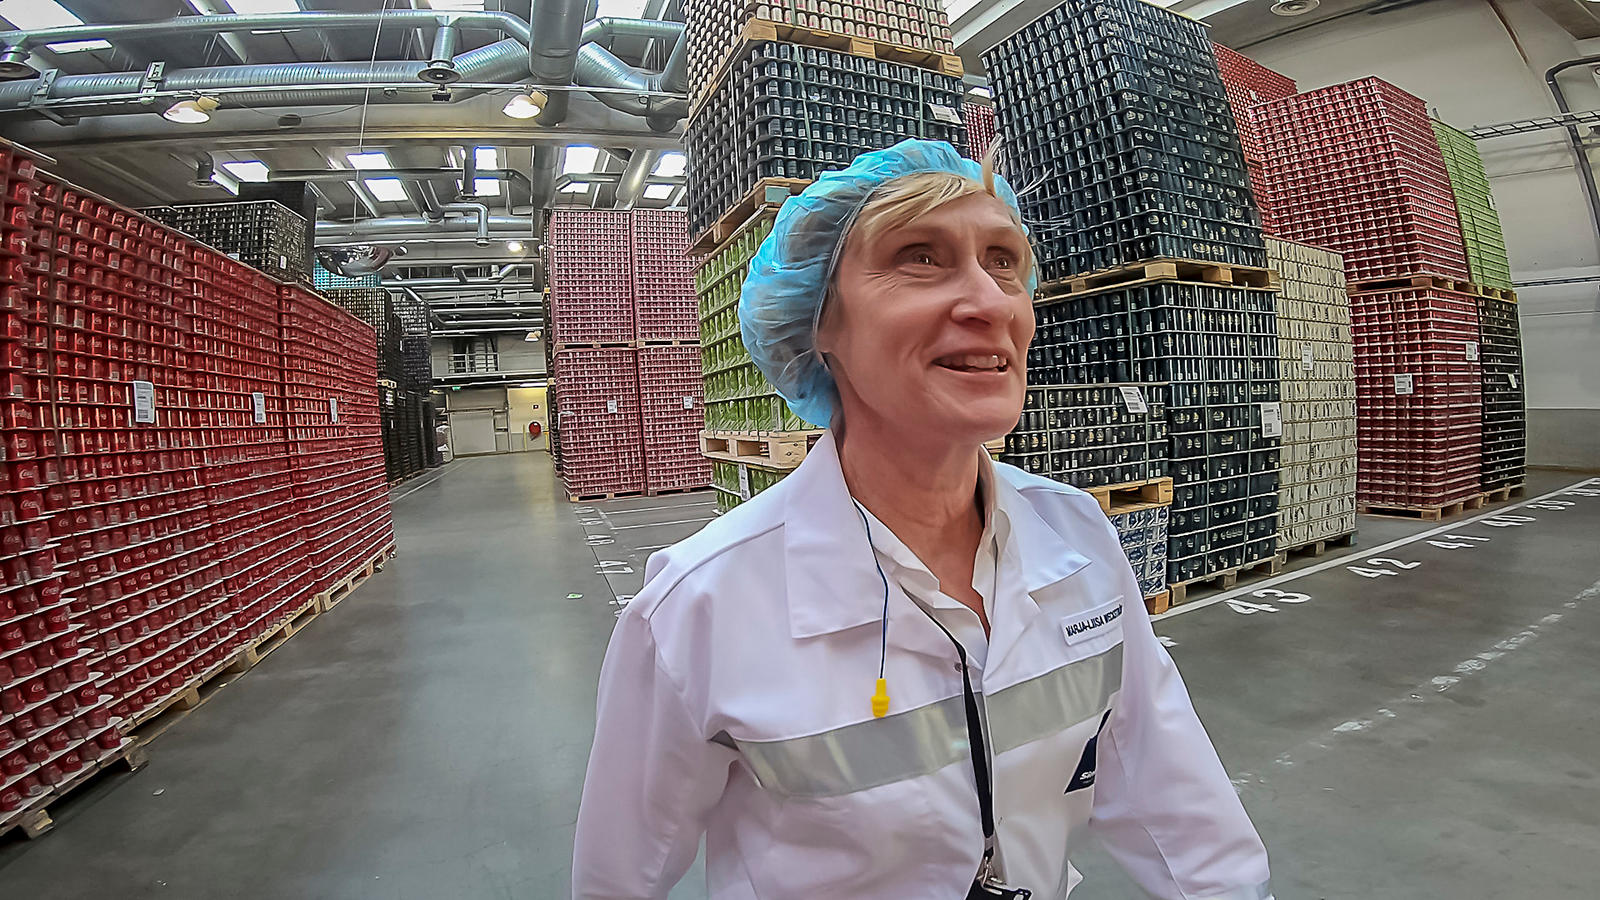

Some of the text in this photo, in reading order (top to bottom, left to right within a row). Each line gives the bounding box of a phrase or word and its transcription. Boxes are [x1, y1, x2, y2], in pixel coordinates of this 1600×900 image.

[1526, 500, 1576, 511] 39
[1480, 515, 1537, 527] 40
[1426, 534, 1491, 549] 41
[1346, 557, 1422, 578] 42
[1224, 588, 1312, 615] 43
